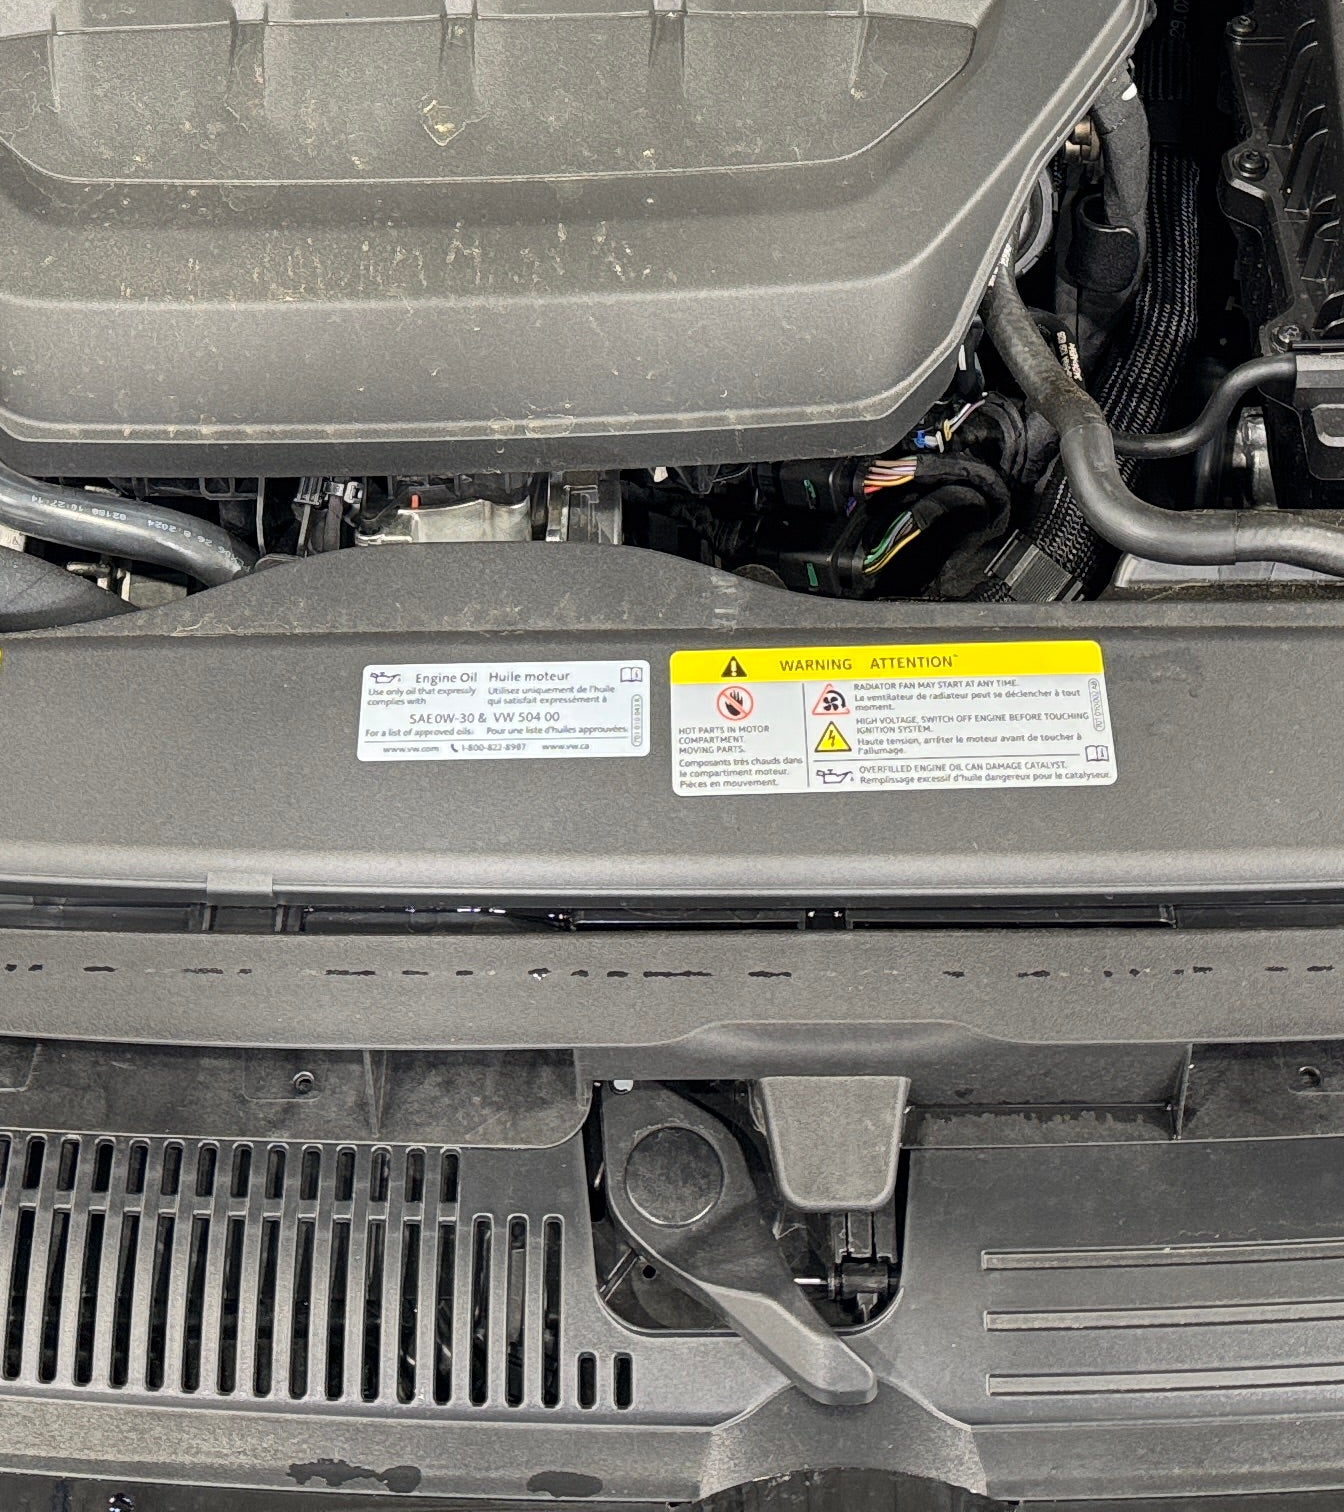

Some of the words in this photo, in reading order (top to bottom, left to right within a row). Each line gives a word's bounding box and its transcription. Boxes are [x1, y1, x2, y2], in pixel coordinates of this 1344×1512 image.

[779, 658, 852, 672] WARNING
[869, 655, 953, 669] ATTENTION
[415, 672, 457, 685] Engine
[459, 671, 477, 683] Oil
[488, 671, 521, 682] Huile
[524, 672, 569, 681] moteur
[487, 686, 520, 695] Utilisez
[588, 684, 615, 693] l'huile
[853, 682, 897, 691] RADIATOR
[898, 681, 916, 689] FAN
[917, 681, 936, 689] MAY
[937, 680, 963, 688] START
[964, 679, 975, 687] AT
[976, 679, 995, 687] ANY
[367, 688, 384, 696] Use
[405, 687, 416, 695] oil
[417, 687, 435, 695] that
[436, 687, 476, 695] expressly
[854, 694, 865, 702] Le
[866, 693, 914, 701] ventilateur
[1004, 689, 1052, 698] déclencher
[1061, 689, 1081, 697] tout
[406, 697, 426, 705] with
[486, 698, 502, 706] qui
[503, 696, 537, 704] satisfait
[409, 713, 433, 724] SAE
[434, 712, 475, 724] 0W-30
[477, 712, 487, 723] &
[493, 711, 515, 723] VW
[518, 711, 540, 722] 504
[543, 711, 560, 722] 00
[855, 717, 878, 725] HIGH
[920, 714, 954, 723] SWITCH
[955, 714, 972, 722] OFF
[974, 713, 1006, 722] ENGINE
[1008, 712, 1042, 721] BEFORE
[1043, 711, 1089, 721] TOUCHING
[364, 728, 379, 737] For
[387, 728, 401, 736] list
[402, 727, 413, 736] of
[486, 726, 506, 735] Pour
[525, 726, 543, 734] liste
[544, 725, 576, 734] d'huiles
[678, 726, 696, 735] HOT
[697, 726, 725, 734] PARTS
[738, 724, 770, 733] MOTOR
[856, 725, 896, 734] IGNITION
[857, 737, 884, 746] Haute
[965, 735, 998, 743] moteur
[1039, 733, 1074, 741] toucher
[678, 746, 714, 754] MOVING
[678, 759, 731, 767] Composants
[750, 757, 781, 765] chauds
[782, 756, 803, 764] dans
[689, 769, 753, 777] compartiment
[858, 764, 912, 774] OVERFILLED
[913, 763, 946, 772] ENGINE
[948, 762, 963, 771] OIL
[964, 762, 983, 771] CAN
[984, 761, 1022, 770] DAMAGE
[916, 775, 951, 783] excessif
[952, 773, 982, 782] d'huile
[984, 773, 1031, 781] dangereux
[1031, 773, 1053, 781] pour
